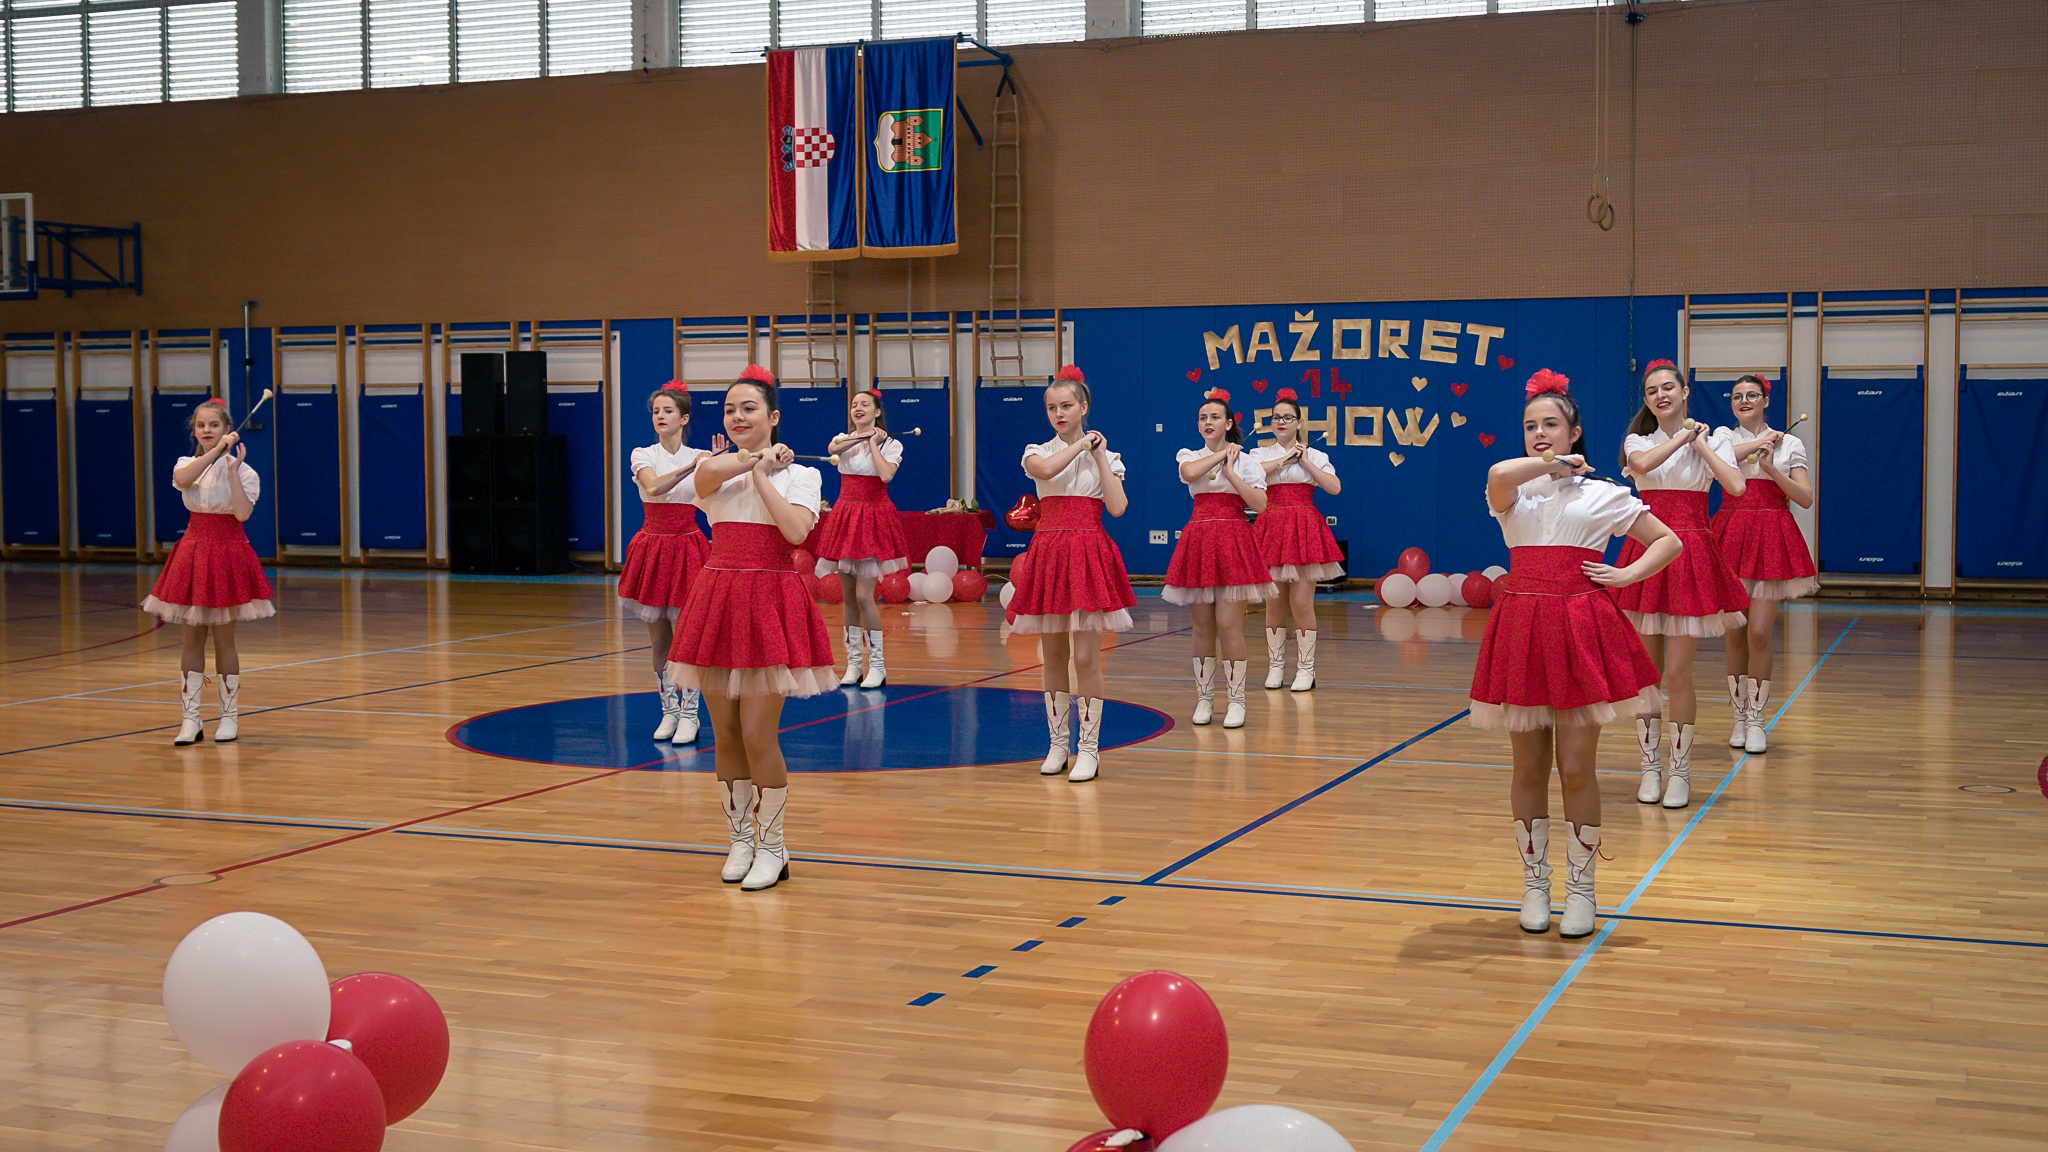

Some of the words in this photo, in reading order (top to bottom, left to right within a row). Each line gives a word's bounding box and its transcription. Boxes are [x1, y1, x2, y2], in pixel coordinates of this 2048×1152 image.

[1203, 310, 1505, 370] MAŽORET
[1301, 367, 1352, 400] 14
[1253, 406, 1440, 447] SHOW
